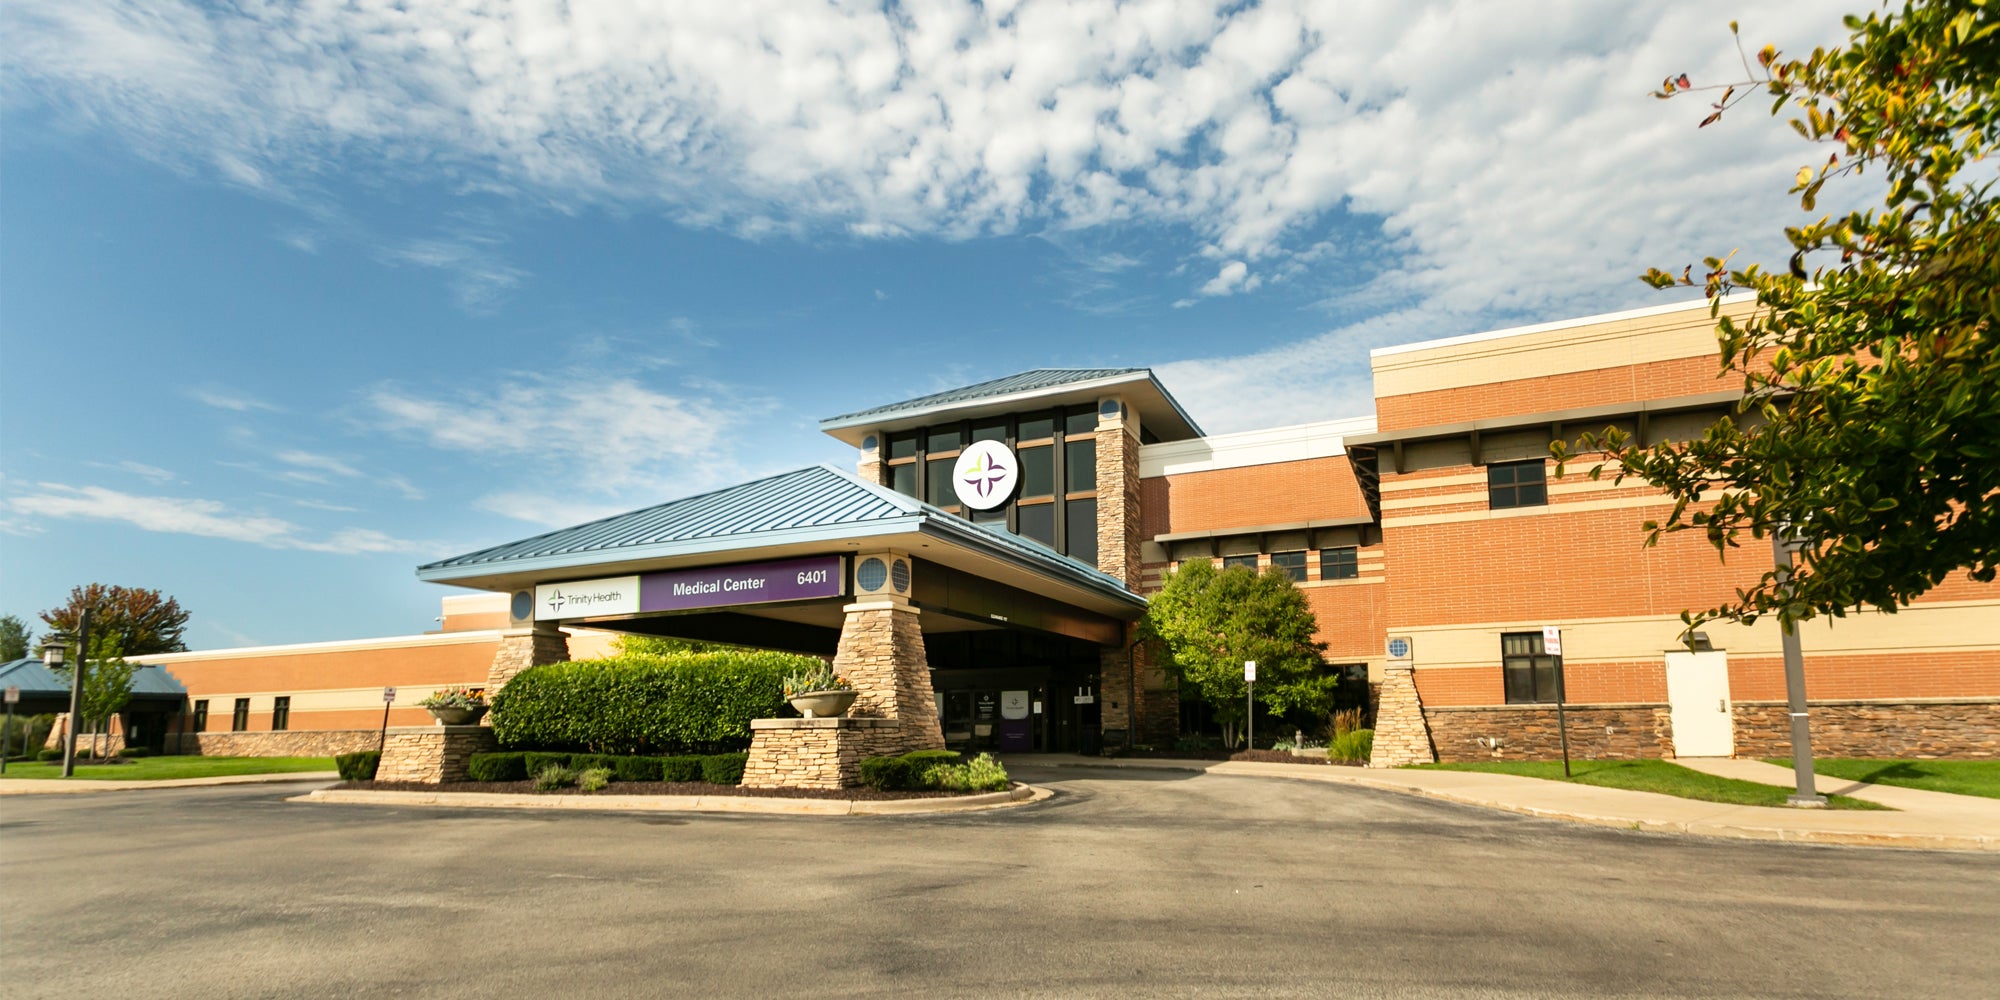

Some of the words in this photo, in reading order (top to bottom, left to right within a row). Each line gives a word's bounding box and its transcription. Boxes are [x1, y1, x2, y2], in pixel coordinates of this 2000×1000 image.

[673, 579, 720, 596] Medical
[723, 577, 765, 592] Center
[797, 569, 827, 585] 6401
[567, 594, 593, 606] Trinity
[593, 590, 622, 603] Health
